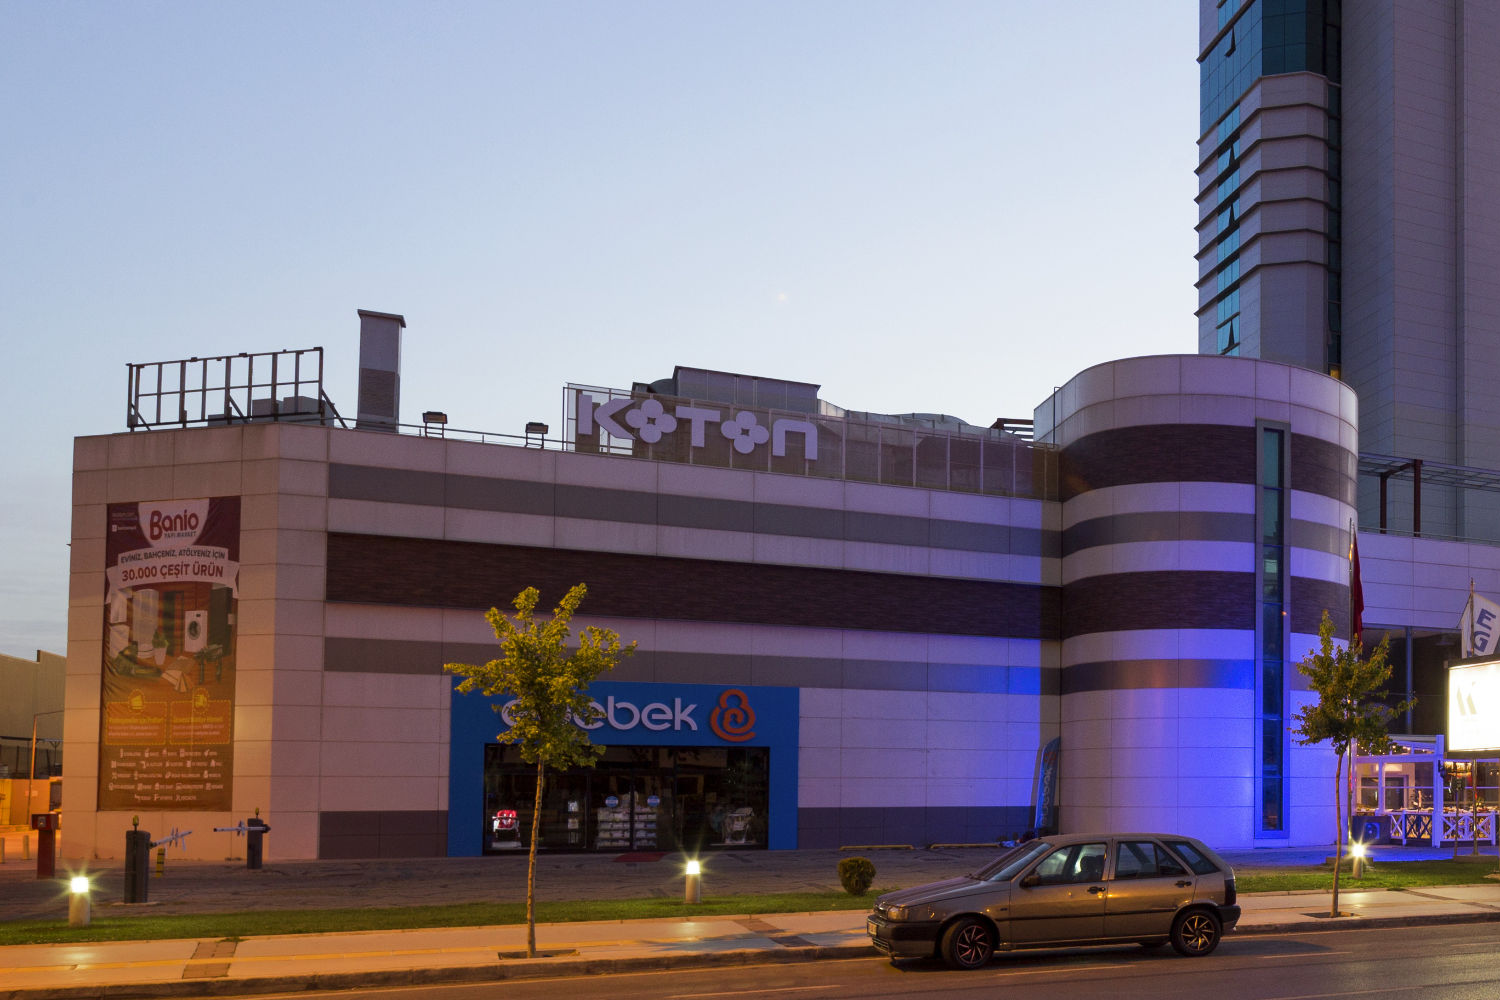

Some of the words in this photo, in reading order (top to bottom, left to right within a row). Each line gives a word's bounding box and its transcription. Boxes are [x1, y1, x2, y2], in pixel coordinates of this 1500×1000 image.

[150, 509, 199, 540] Banio
[122, 566, 158, 581] 30.000
[160, 561, 190, 579] ÇEŞİT
[192, 561, 224, 578] ÜRÜN
[1469, 608, 1497, 657] EG
[502, 696, 698, 731] eebek
